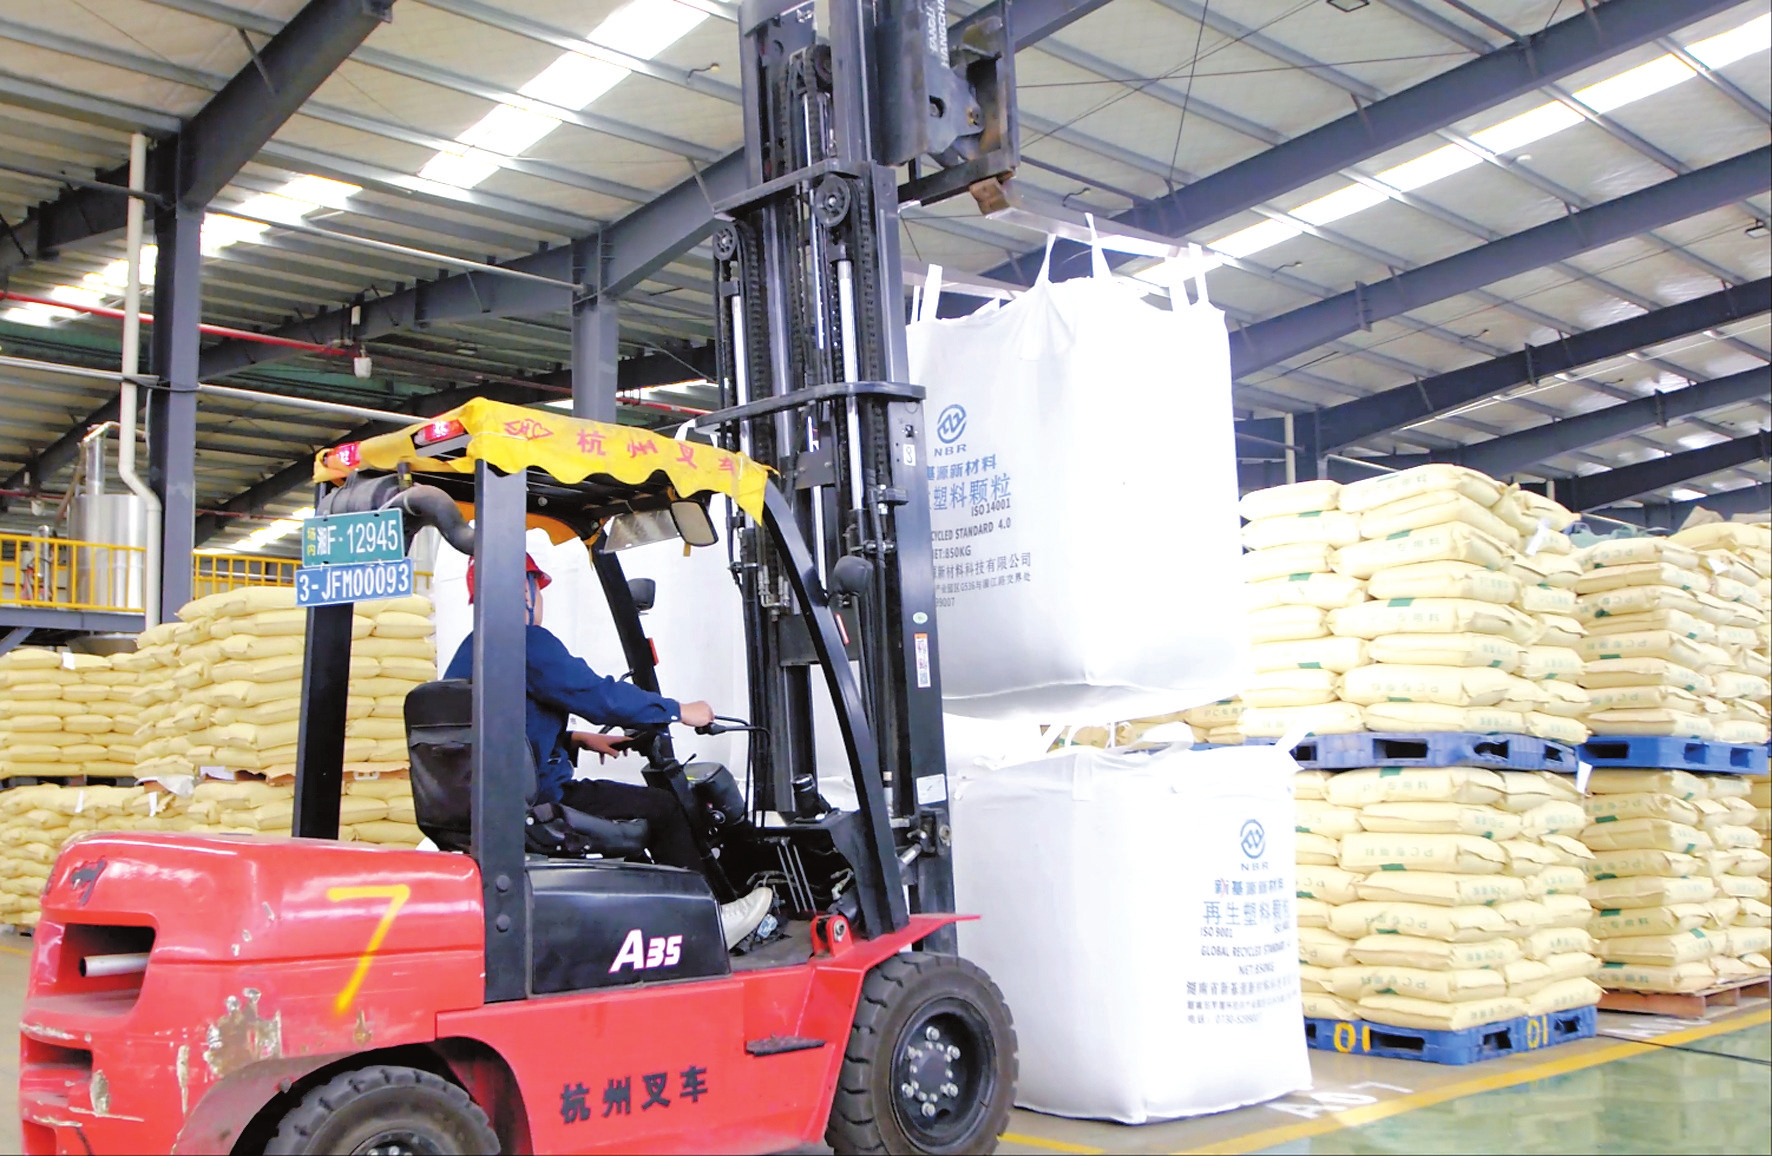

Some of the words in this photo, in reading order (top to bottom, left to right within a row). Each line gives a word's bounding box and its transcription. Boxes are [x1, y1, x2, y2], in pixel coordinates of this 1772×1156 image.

[934, 443, 967, 457] NBR
[955, 521, 994, 540] STANDARD
[998, 517, 1011, 530] 4.0
[328, 884, 410, 1016] 7
[608, 929, 683, 974] A35
[1334, 1021, 1372, 1053] 01
[1527, 1015, 1549, 1049] 01
[560, 1064, 709, 1125] 杭州叉车
